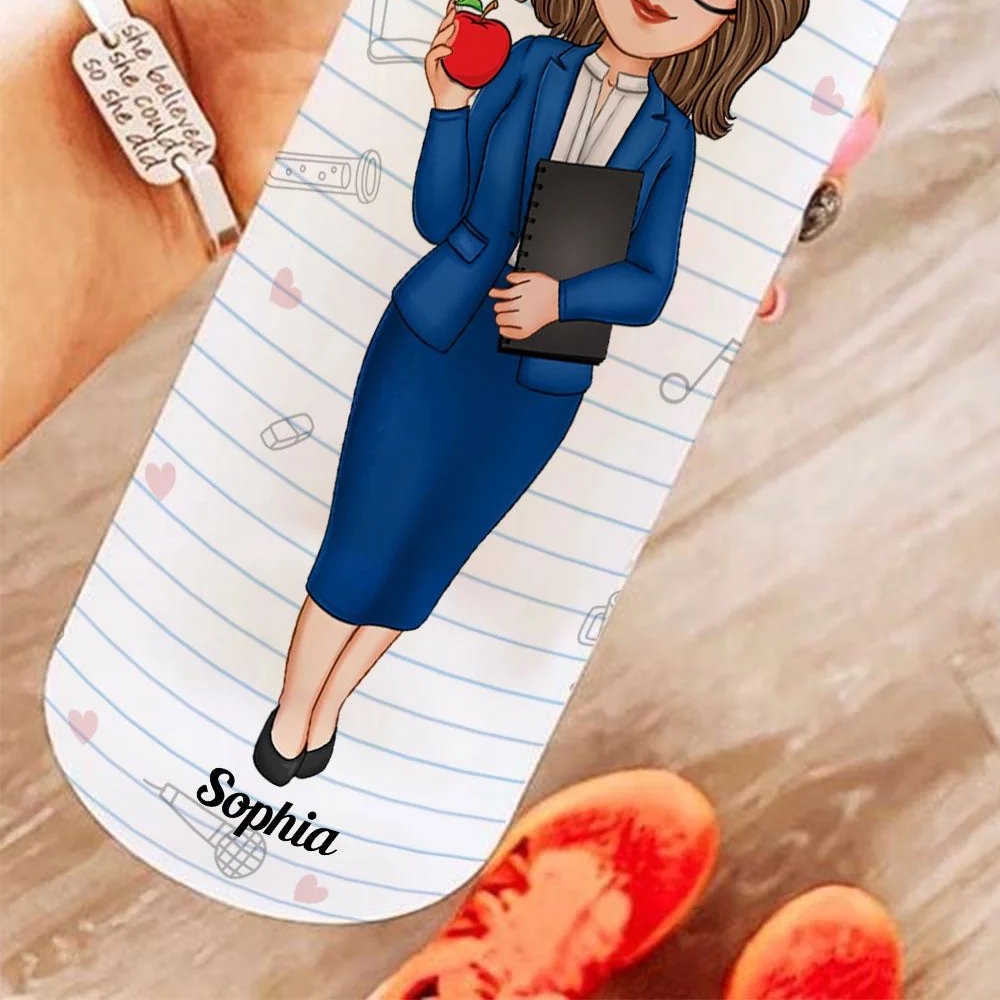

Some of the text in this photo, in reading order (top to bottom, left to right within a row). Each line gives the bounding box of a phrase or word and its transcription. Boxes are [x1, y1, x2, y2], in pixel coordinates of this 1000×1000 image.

[101, 89, 134, 126] she
[126, 133, 167, 172] did
[108, 51, 187, 154] she could
[121, 24, 212, 156] she believed
[196, 767, 340, 855] Sophia
